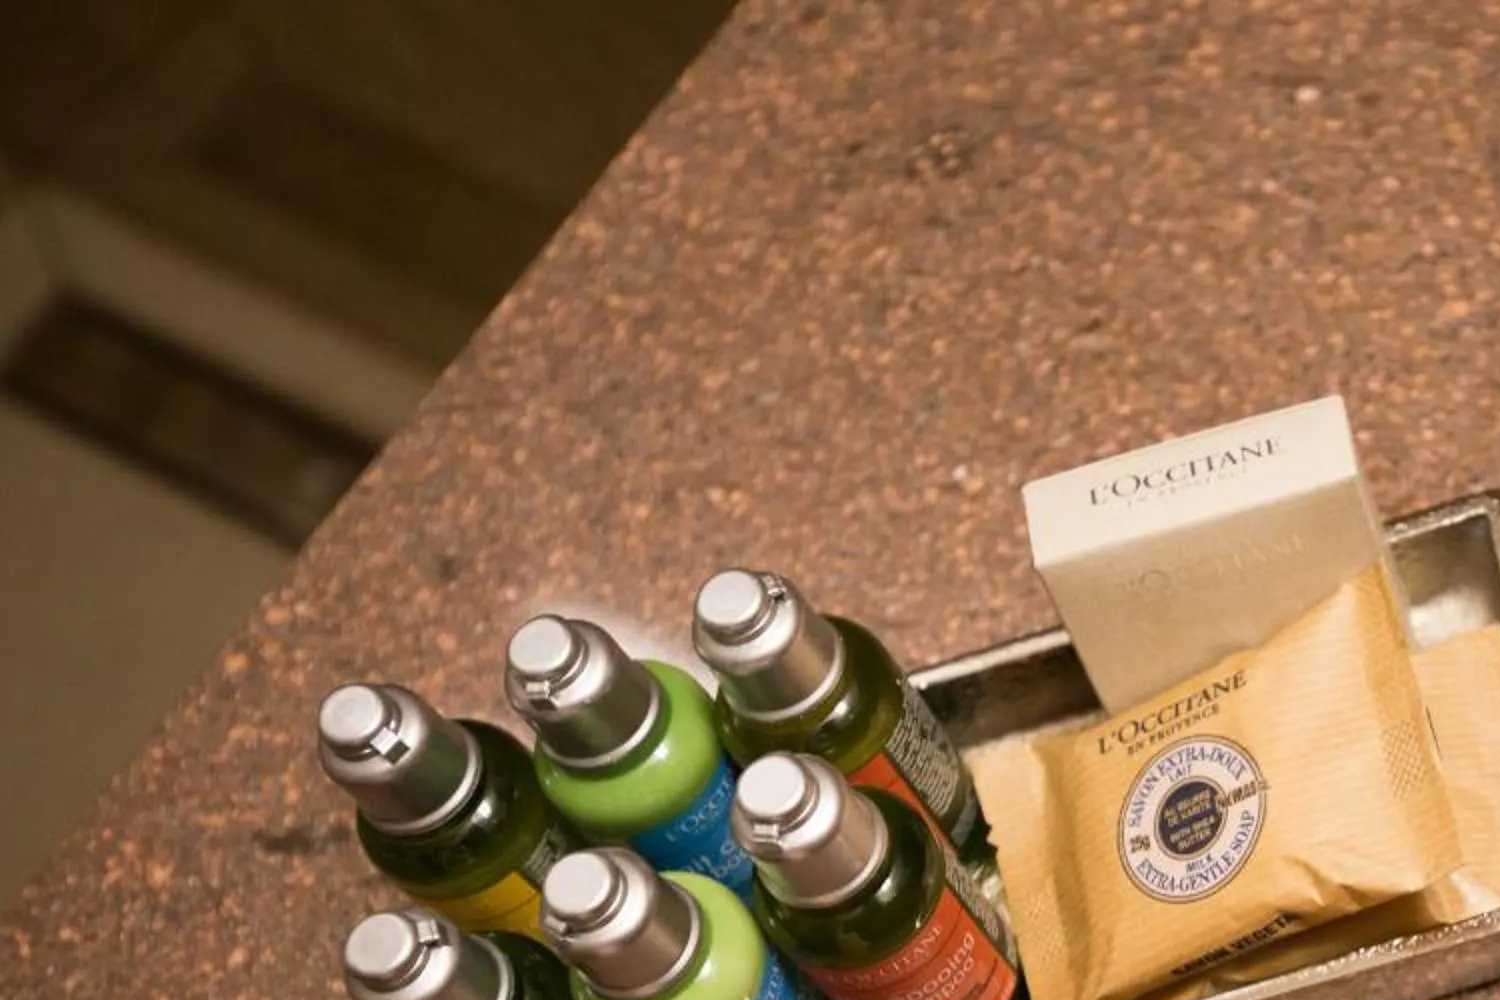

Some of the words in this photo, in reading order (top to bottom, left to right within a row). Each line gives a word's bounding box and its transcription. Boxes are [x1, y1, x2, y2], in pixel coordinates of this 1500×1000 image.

[1089, 438, 1283, 506] L'OCCITANE
[1098, 669, 1247, 755] L'OCCITANE
[1128, 775, 1160, 829] SAVON
[1157, 744, 1247, 783] EXTRA-DOUX
[1135, 852, 1236, 893] EXTRA-GENTLE
[1229, 809, 1256, 856] SOAP
